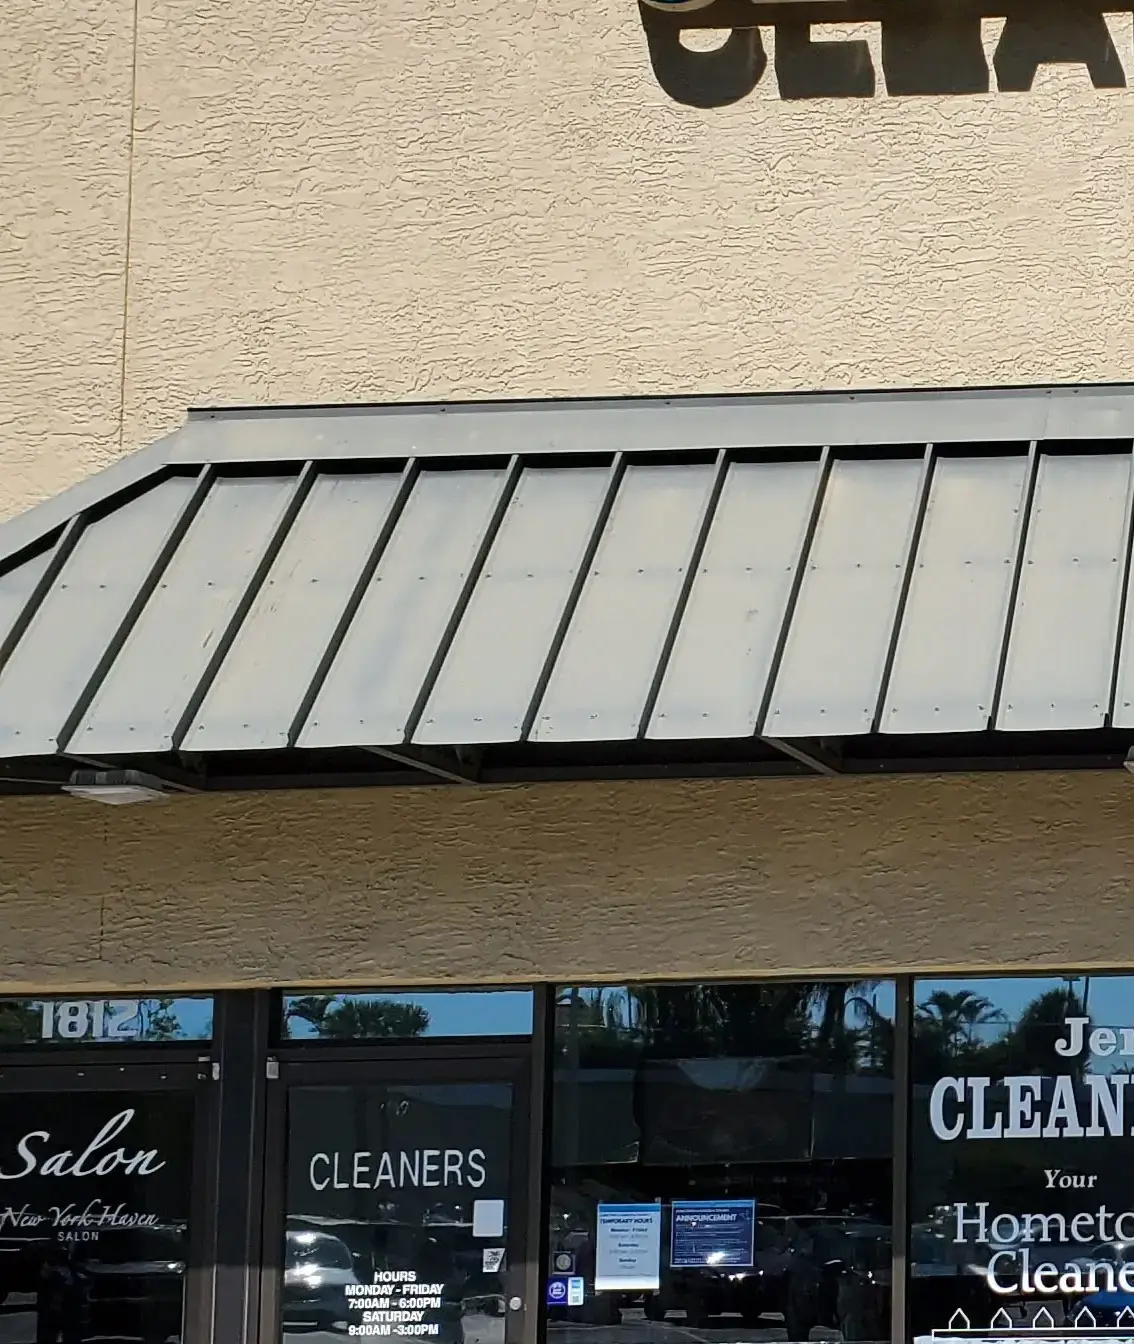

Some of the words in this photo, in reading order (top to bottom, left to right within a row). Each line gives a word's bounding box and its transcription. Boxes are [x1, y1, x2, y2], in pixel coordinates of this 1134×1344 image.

[40, 1000, 140, 1039] 1812
[0, 1108, 166, 1179] Salon
[310, 1149, 486, 1191] CLEANERS
[1043, 1169, 1098, 1189] Your
[0, 1204, 44, 1232] New
[48, 1199, 101, 1227] York
[98, 1203, 159, 1227] Haven
[57, 1231, 99, 1242] SALON
[374, 1271, 417, 1283] HOURS
[345, 1284, 395, 1296] MONDAY
[402, 1284, 444, 1295] FRIDAY
[348, 1297, 390, 1309] 7:00AM
[399, 1297, 441, 1309] 6:00PM
[363, 1311, 424, 1322] SATURDAY
[348, 1324, 390, 1336] 9:00AM
